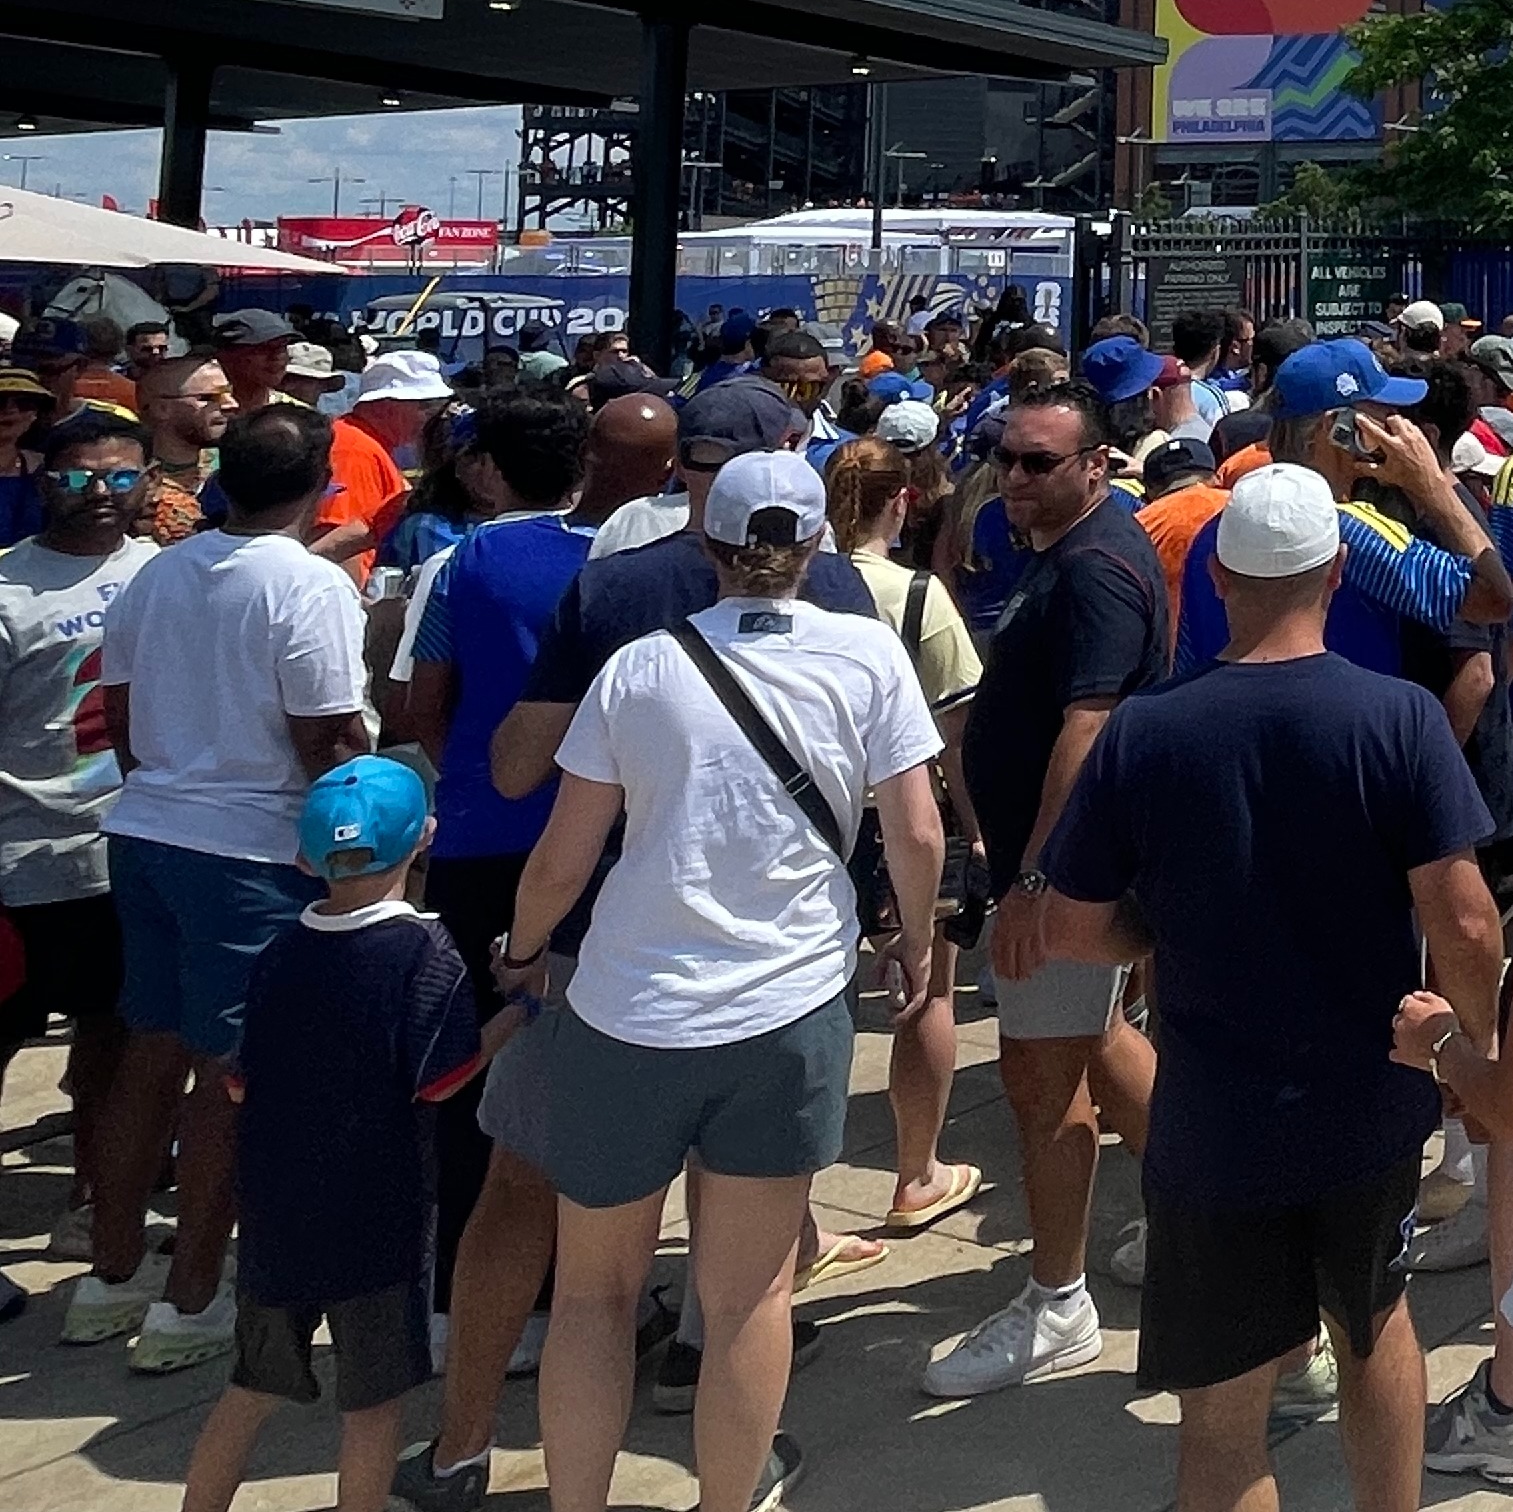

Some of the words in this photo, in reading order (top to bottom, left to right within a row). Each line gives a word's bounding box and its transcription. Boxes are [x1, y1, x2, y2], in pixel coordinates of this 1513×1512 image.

[460, 226, 493, 238] ZONE
[1310, 266, 1333, 280] ALL
[1334, 266, 1386, 279] VEHICLES
[1338, 284, 1362, 297] ARE
[1315, 302, 1366, 316] SUBJECT
[1367, 301, 1383, 315] TO
